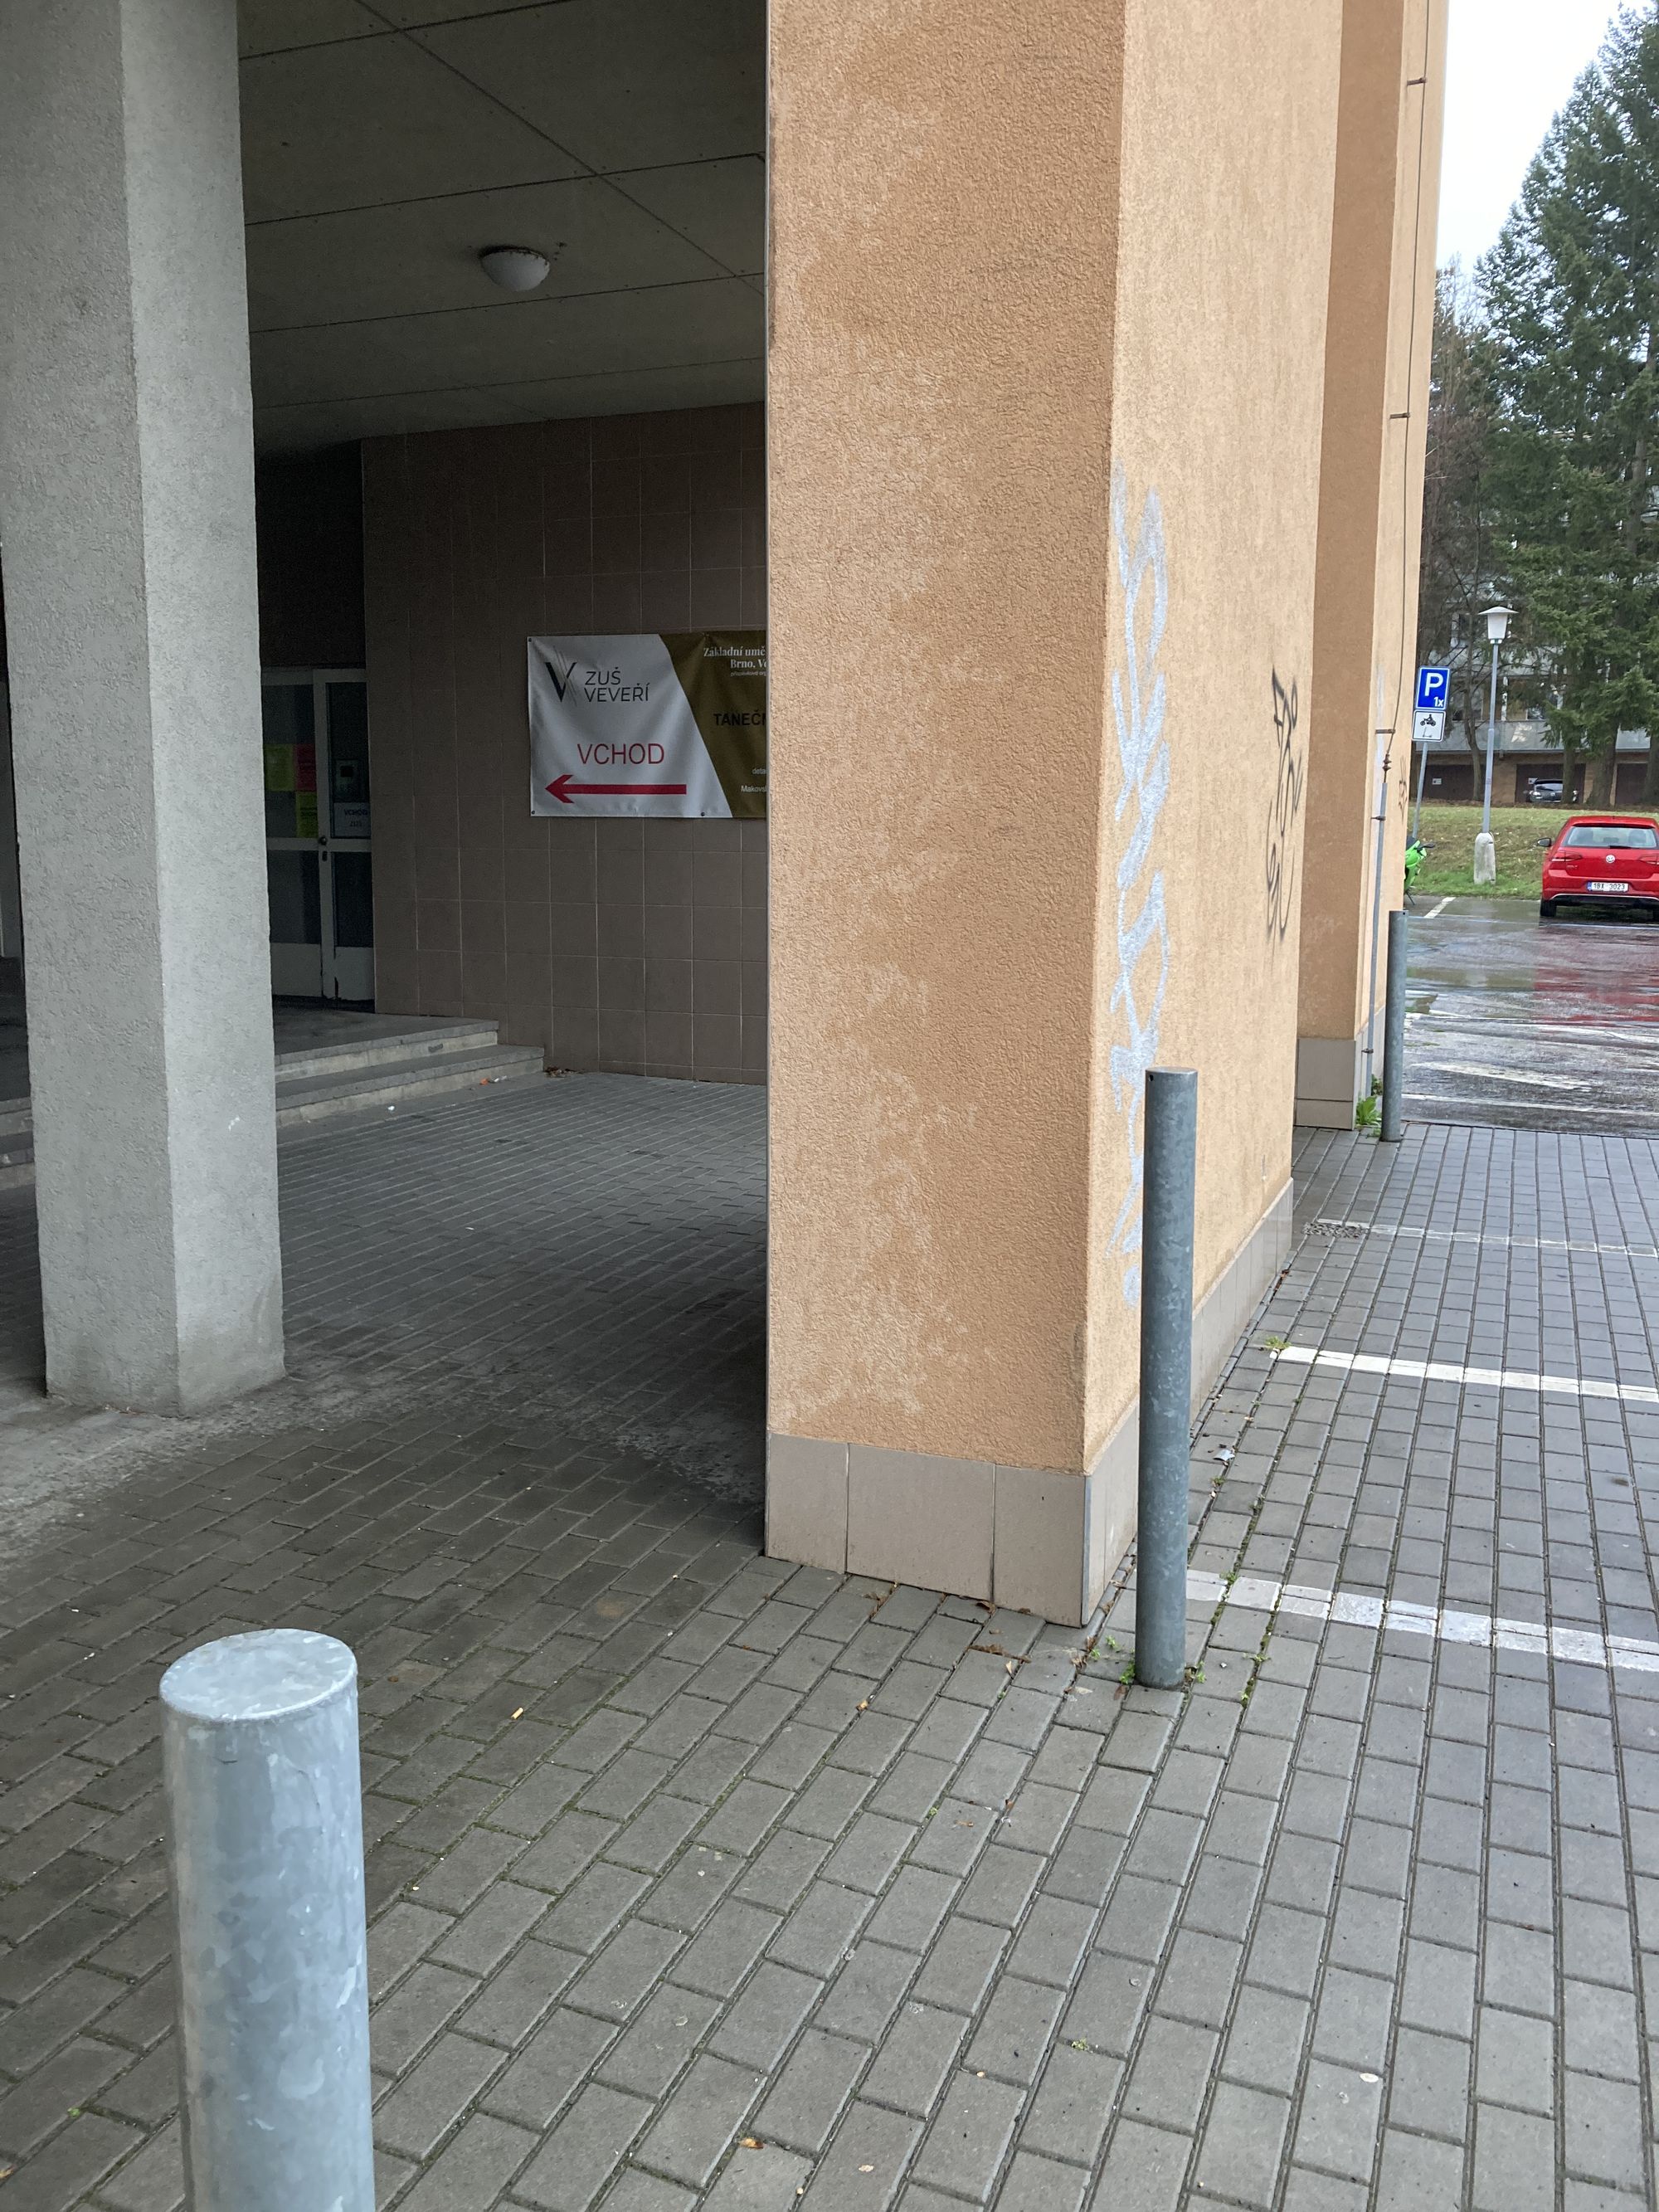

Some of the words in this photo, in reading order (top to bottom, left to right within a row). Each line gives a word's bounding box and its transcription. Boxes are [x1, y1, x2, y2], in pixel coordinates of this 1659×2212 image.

[703, 646, 743, 657] Základní
[585, 666, 621, 685] ZUŠ
[1425, 673, 1444, 697] P
[584, 683, 650, 702] VEVEŘÍ
[1433, 696, 1444, 707] 1x
[577, 743, 664, 764] VCHOD
